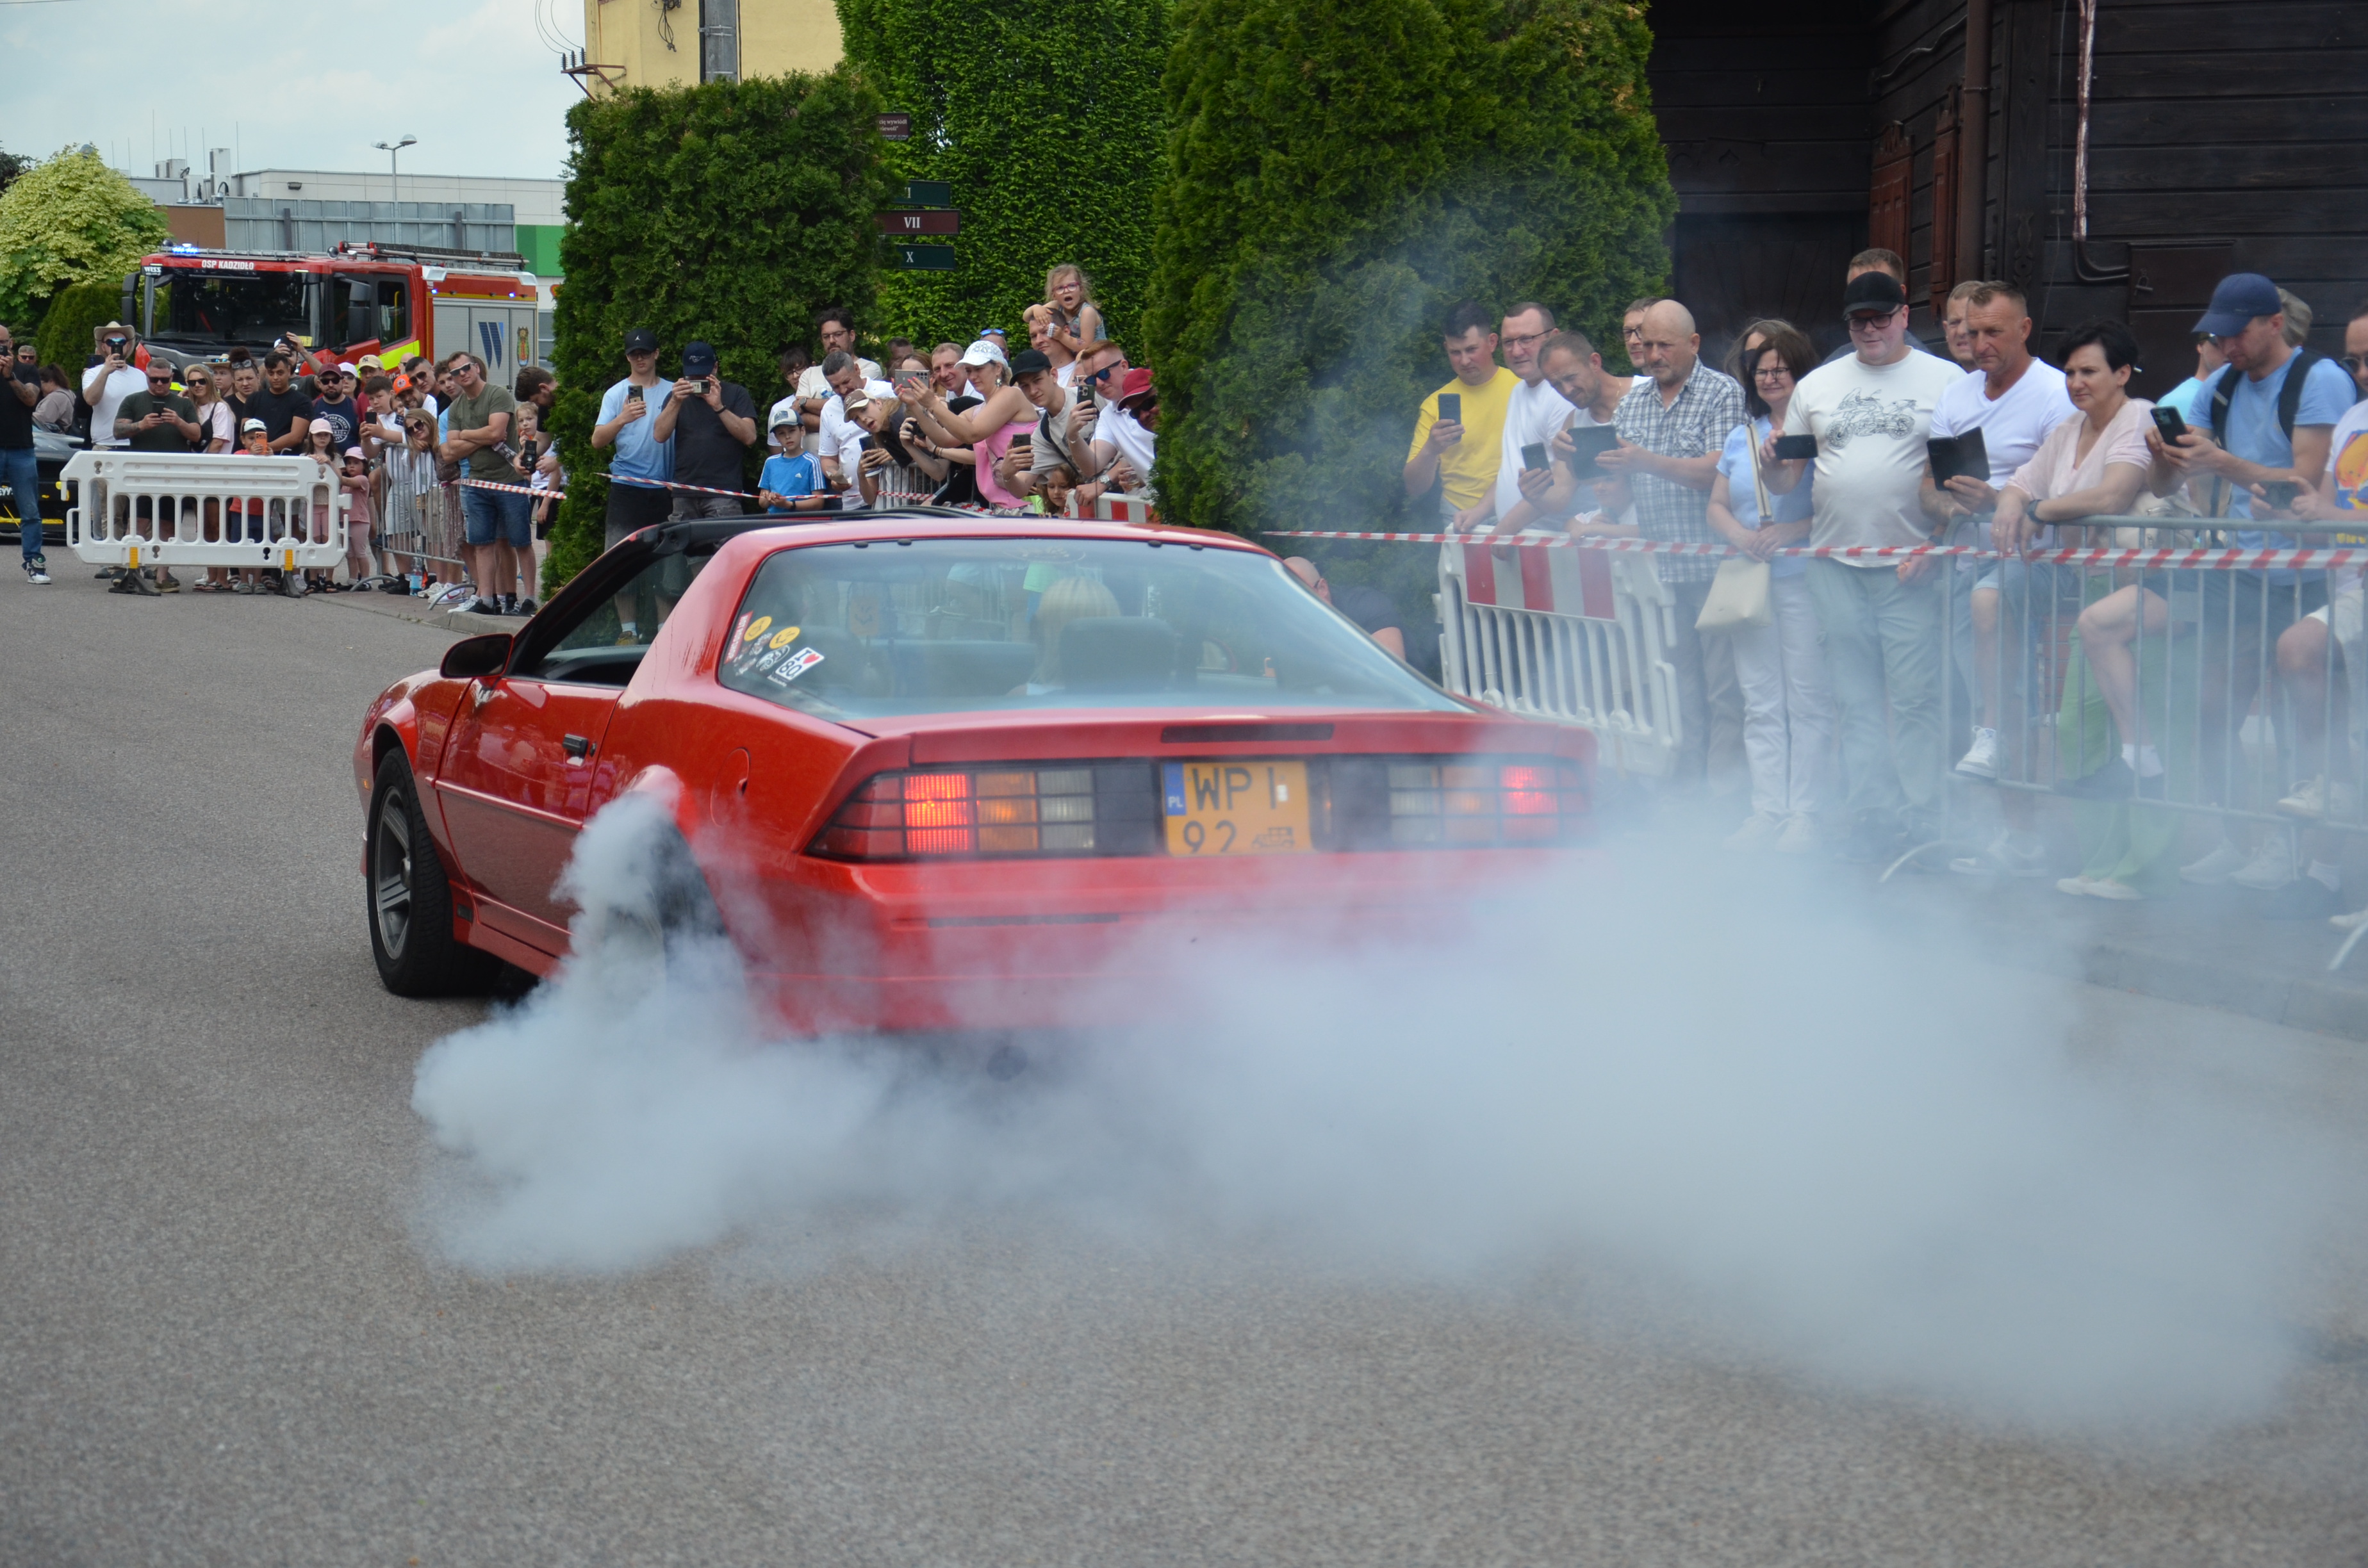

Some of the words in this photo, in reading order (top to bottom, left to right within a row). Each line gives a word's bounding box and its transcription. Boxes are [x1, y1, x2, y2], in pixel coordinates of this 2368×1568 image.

[903, 216, 921, 229] VII
[906, 251, 914, 263] X
[201, 259, 217, 268] OSP
[218, 260, 254, 270] KADZIDŁO
[1167, 796, 1184, 808] PL
